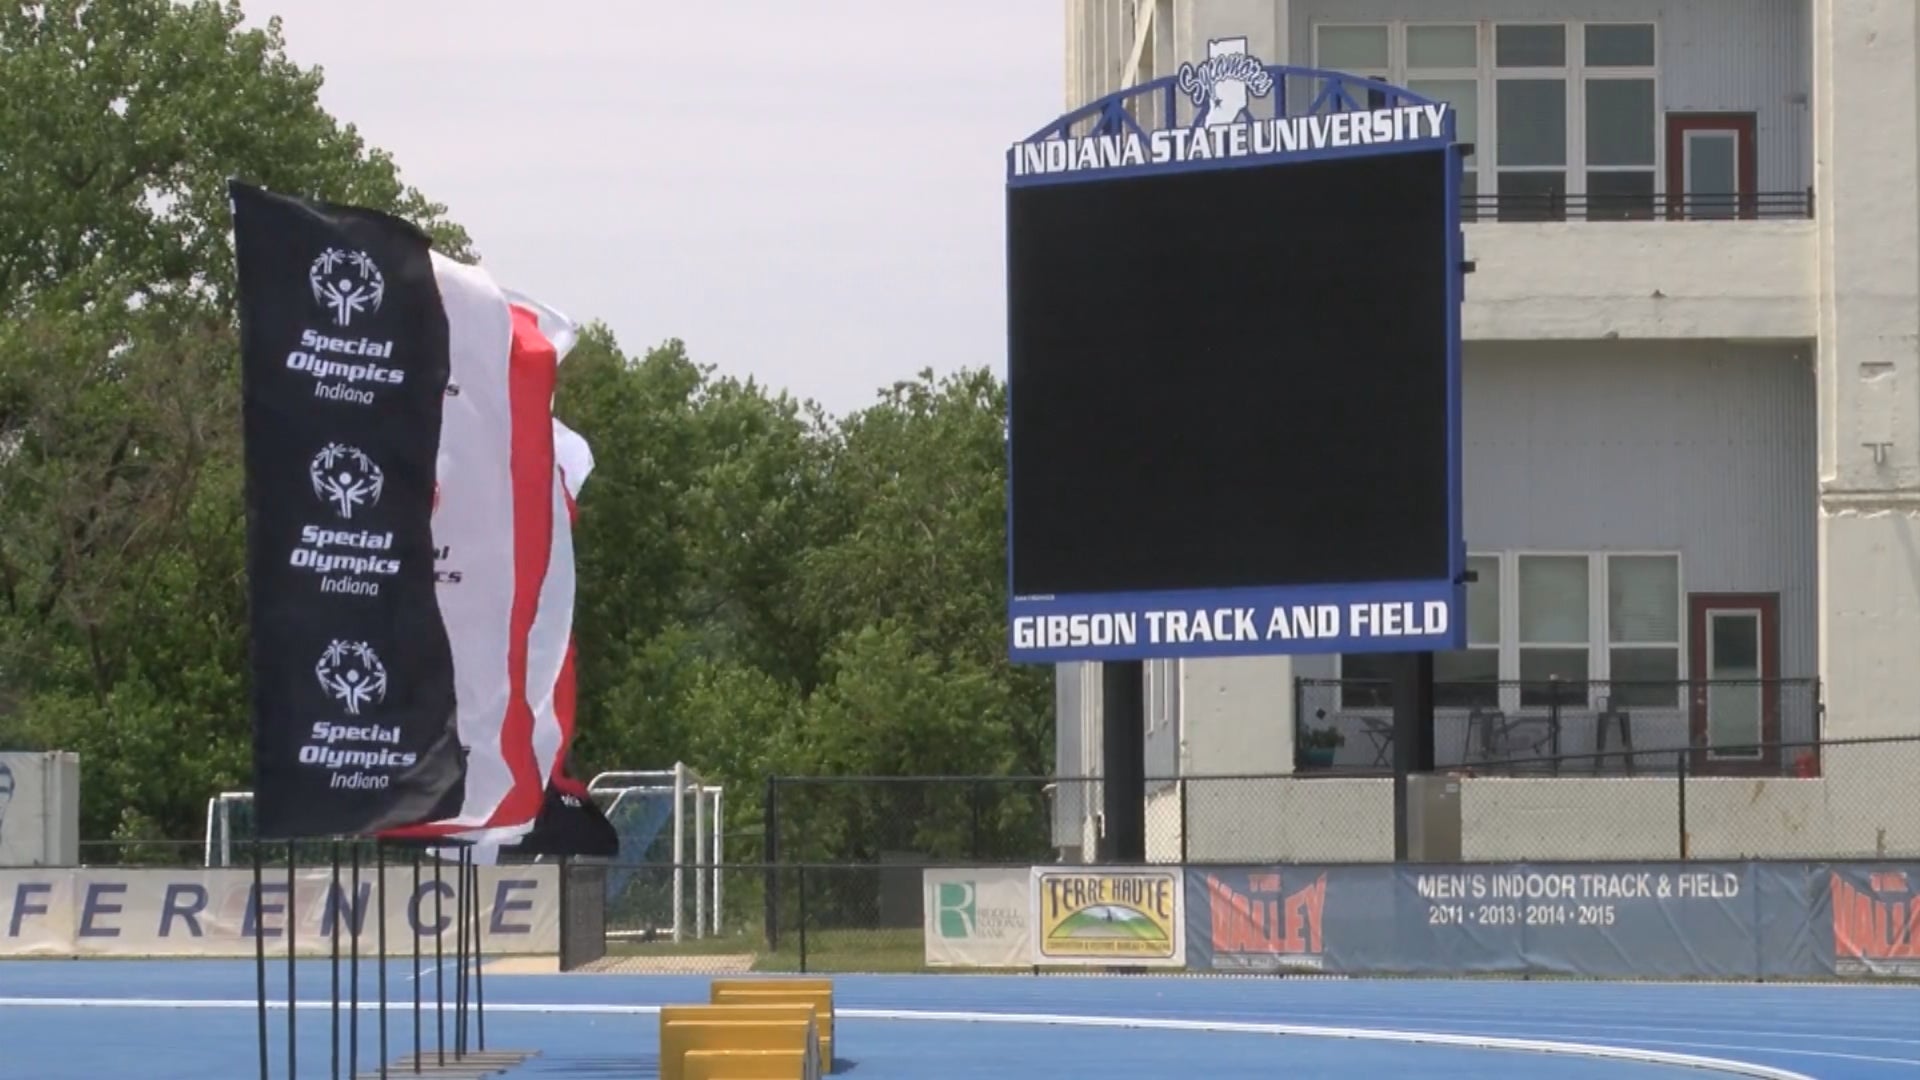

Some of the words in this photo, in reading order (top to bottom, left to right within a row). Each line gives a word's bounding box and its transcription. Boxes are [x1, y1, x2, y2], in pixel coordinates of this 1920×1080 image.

[1179, 51, 1273, 107] Sycamores
[1013, 137, 1144, 175] INDIANA
[1150, 122, 1247, 162] STATE
[1255, 103, 1449, 153] UNIVERSITY
[301, 330, 393, 359] Special
[286, 353, 405, 384] Olympics
[314, 381, 375, 405] Indiana
[301, 526, 393, 550] Special
[290, 551, 401, 575] Olympics
[320, 576, 379, 597] Indiana
[1013, 611, 1137, 649] GIBSON
[1144, 607, 1259, 643] TRACK
[1266, 604, 1340, 639] AND
[1349, 601, 1449, 636] FIELD
[312, 721, 401, 745] Special
[299, 746, 416, 769] Olympics
[330, 771, 389, 789] Indiana
[1418, 874, 1486, 898] MEN'S
[1492, 874, 1576, 898] INDOOR
[1580, 873, 1651, 898] TRACK
[1656, 873, 1672, 898] &
[1678, 873, 1739, 897] FIELD
[1046, 878, 1105, 919] TERRE
[1112, 878, 1170, 919] HAUTE
[1207, 871, 1327, 953] VALLEY
[1429, 906, 1463, 924] 2011
[1479, 906, 1515, 924] 2013
[1526, 906, 1565, 924] 2014
[1578, 906, 1615, 925] 2015
